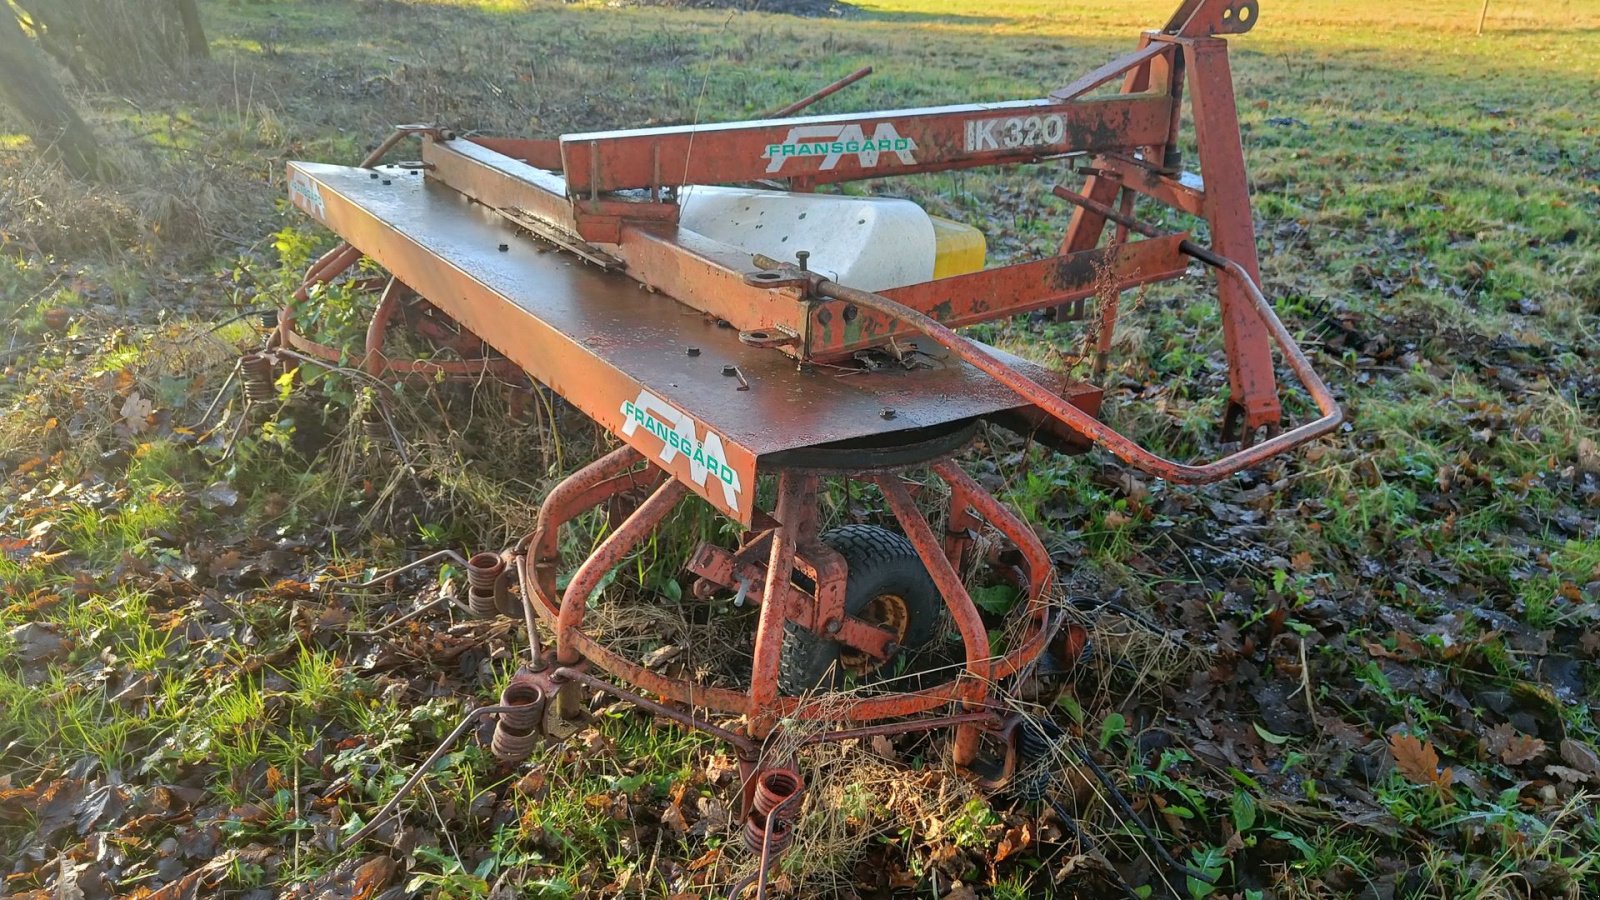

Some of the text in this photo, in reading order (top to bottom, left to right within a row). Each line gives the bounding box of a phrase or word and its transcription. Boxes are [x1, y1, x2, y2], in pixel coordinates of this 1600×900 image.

[967, 115, 1063, 151] IK 320
[625, 402, 733, 485] FRANSGÅRD
